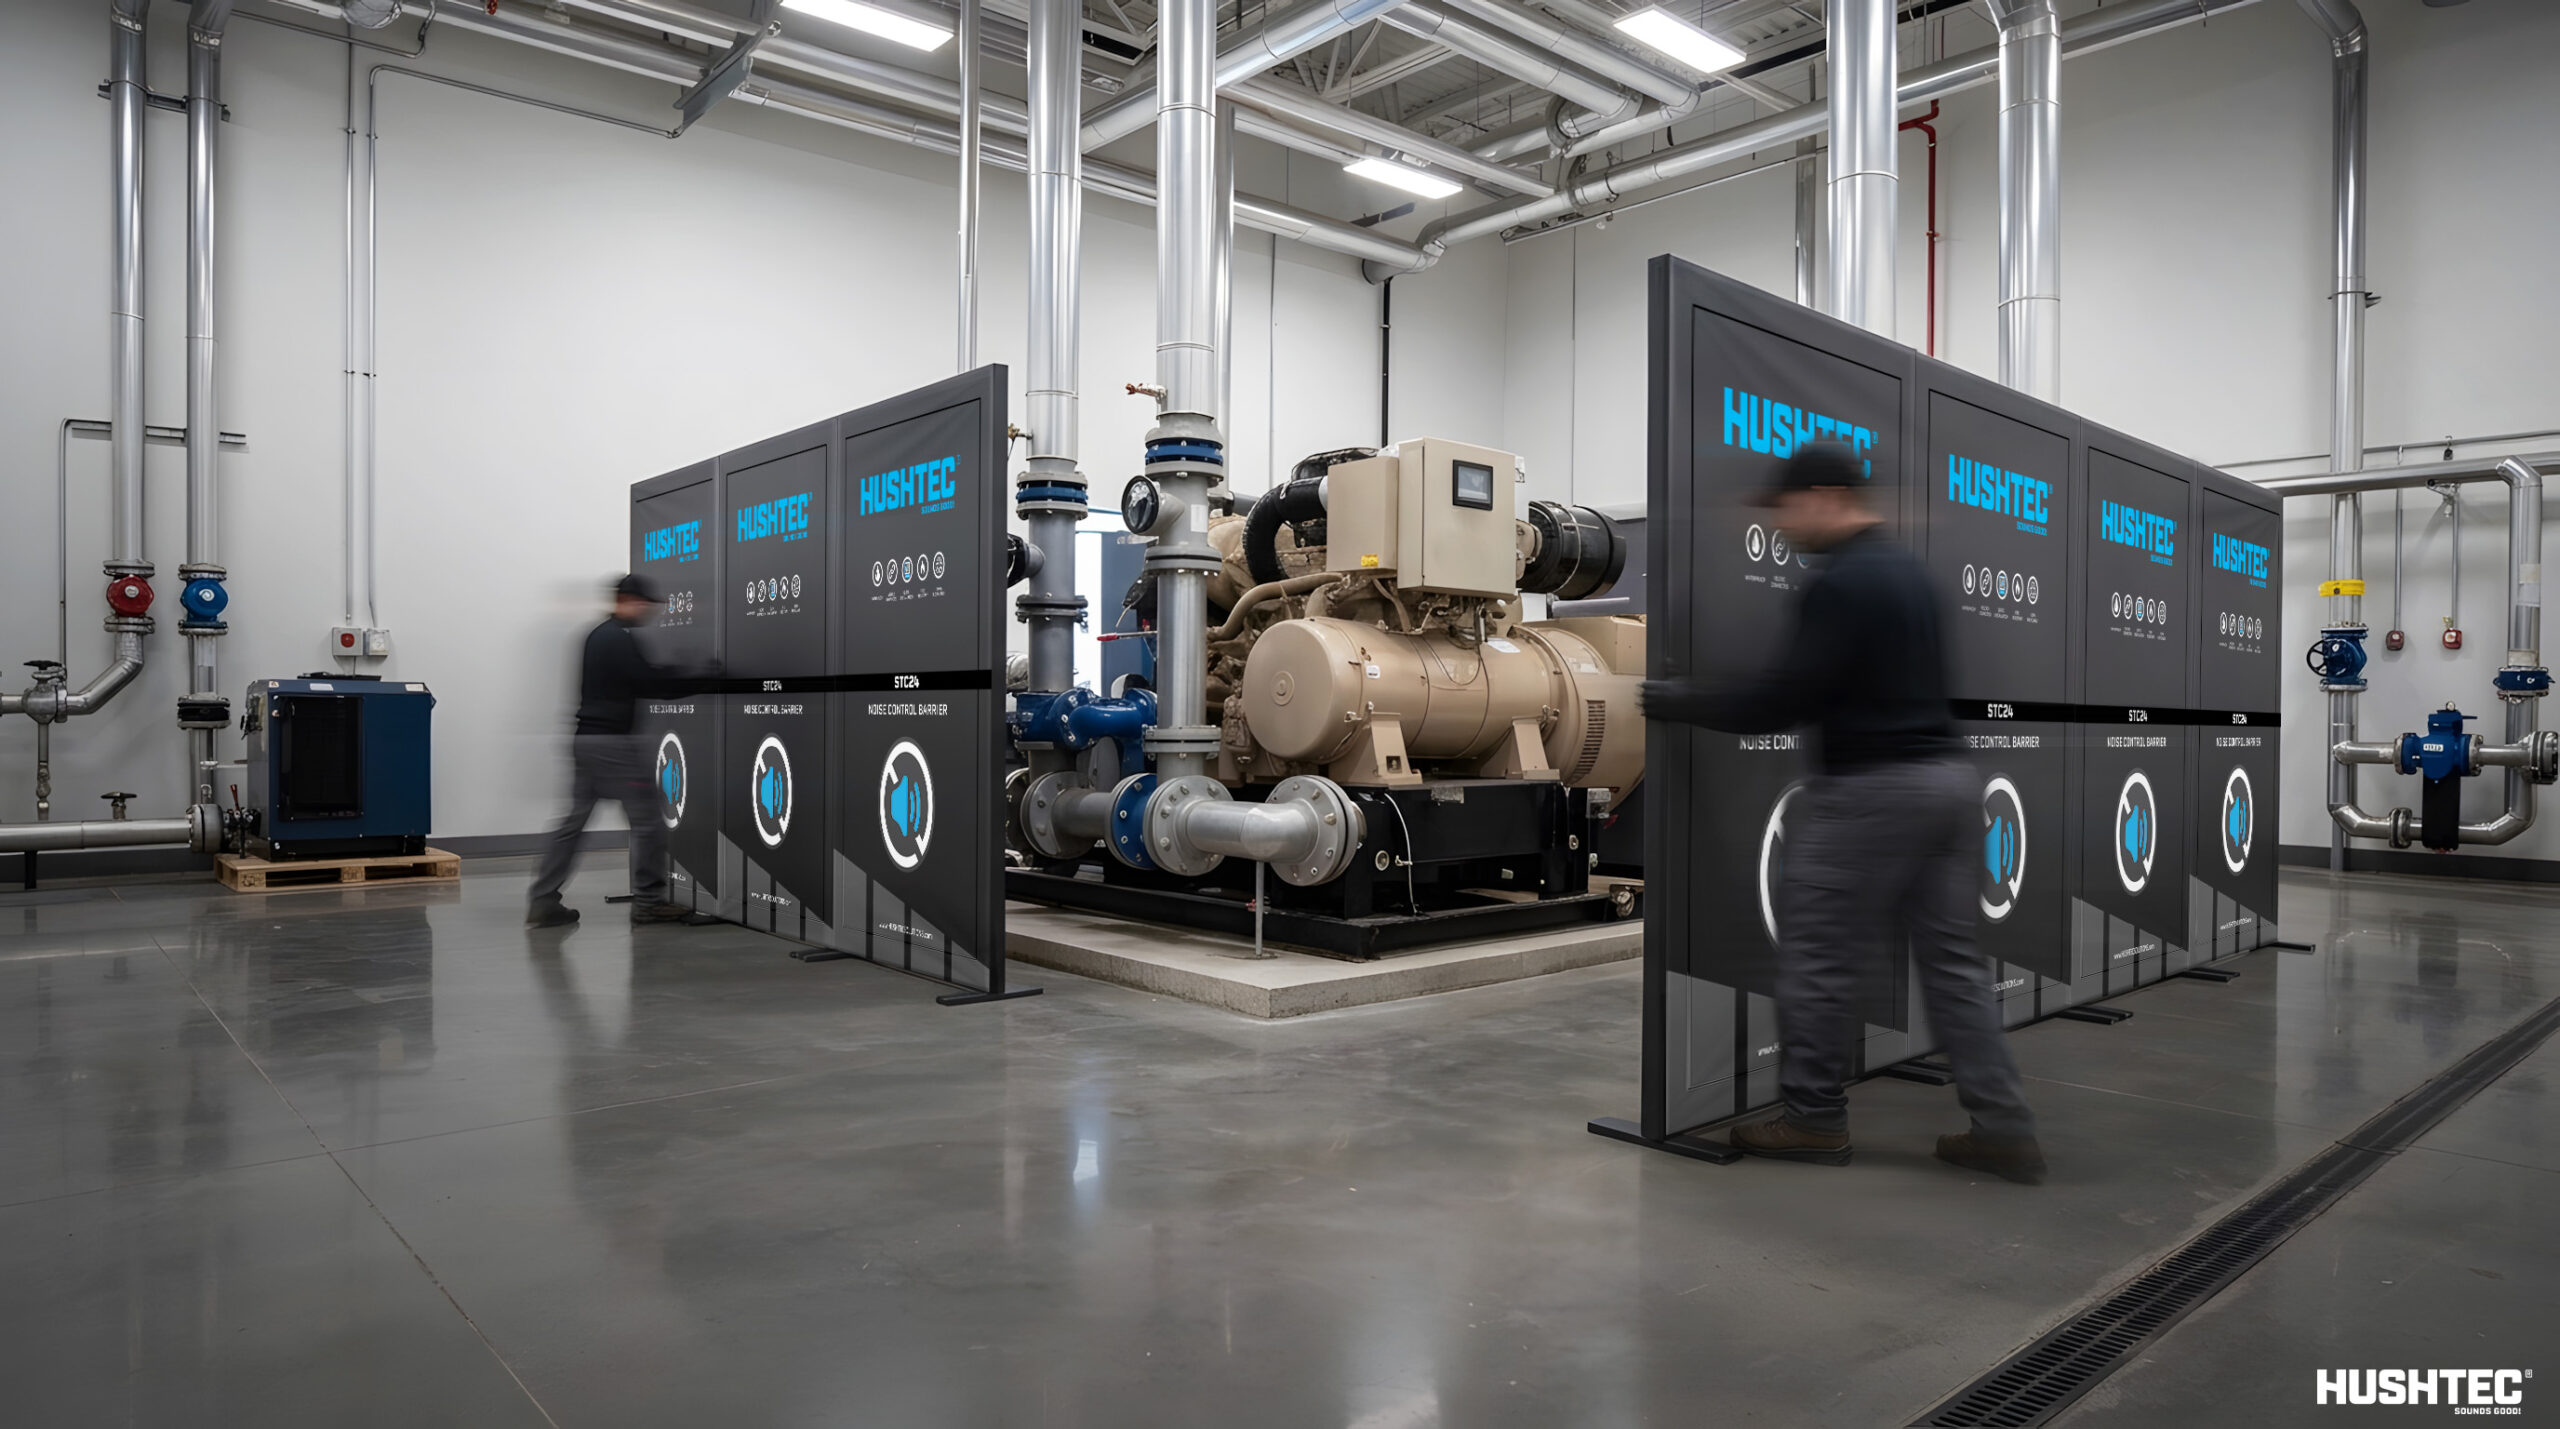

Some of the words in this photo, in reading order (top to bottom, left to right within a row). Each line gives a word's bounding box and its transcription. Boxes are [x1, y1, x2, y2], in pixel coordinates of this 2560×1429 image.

[860, 456, 956, 516] HUSHTEC
[1948, 453, 2048, 524] HUSHTEC
[737, 492, 808, 542] HUSHTEC
[2102, 499, 2174, 556] HUSHTEC
[644, 520, 699, 562] HUSHTEC
[2212, 532, 2268, 579] HUSHTEC
[763, 680, 782, 691] STC24
[894, 675, 920, 689] STC24
[868, 704, 887, 715] NOISE
[887, 704, 917, 715] CONTROL
[918, 704, 948, 715] BARRIER
[1987, 703, 2014, 718] STC24
[2128, 709, 2148, 722] STC24
[1740, 734, 1771, 750] NOISE
[1773, 734, 1801, 750] CONT
[1980, 735, 2011, 748] CONTROL
[2012, 735, 2040, 748] BARRIER
[2107, 736, 2123, 747] NOISE
[2146, 736, 2167, 747] BARRIER
